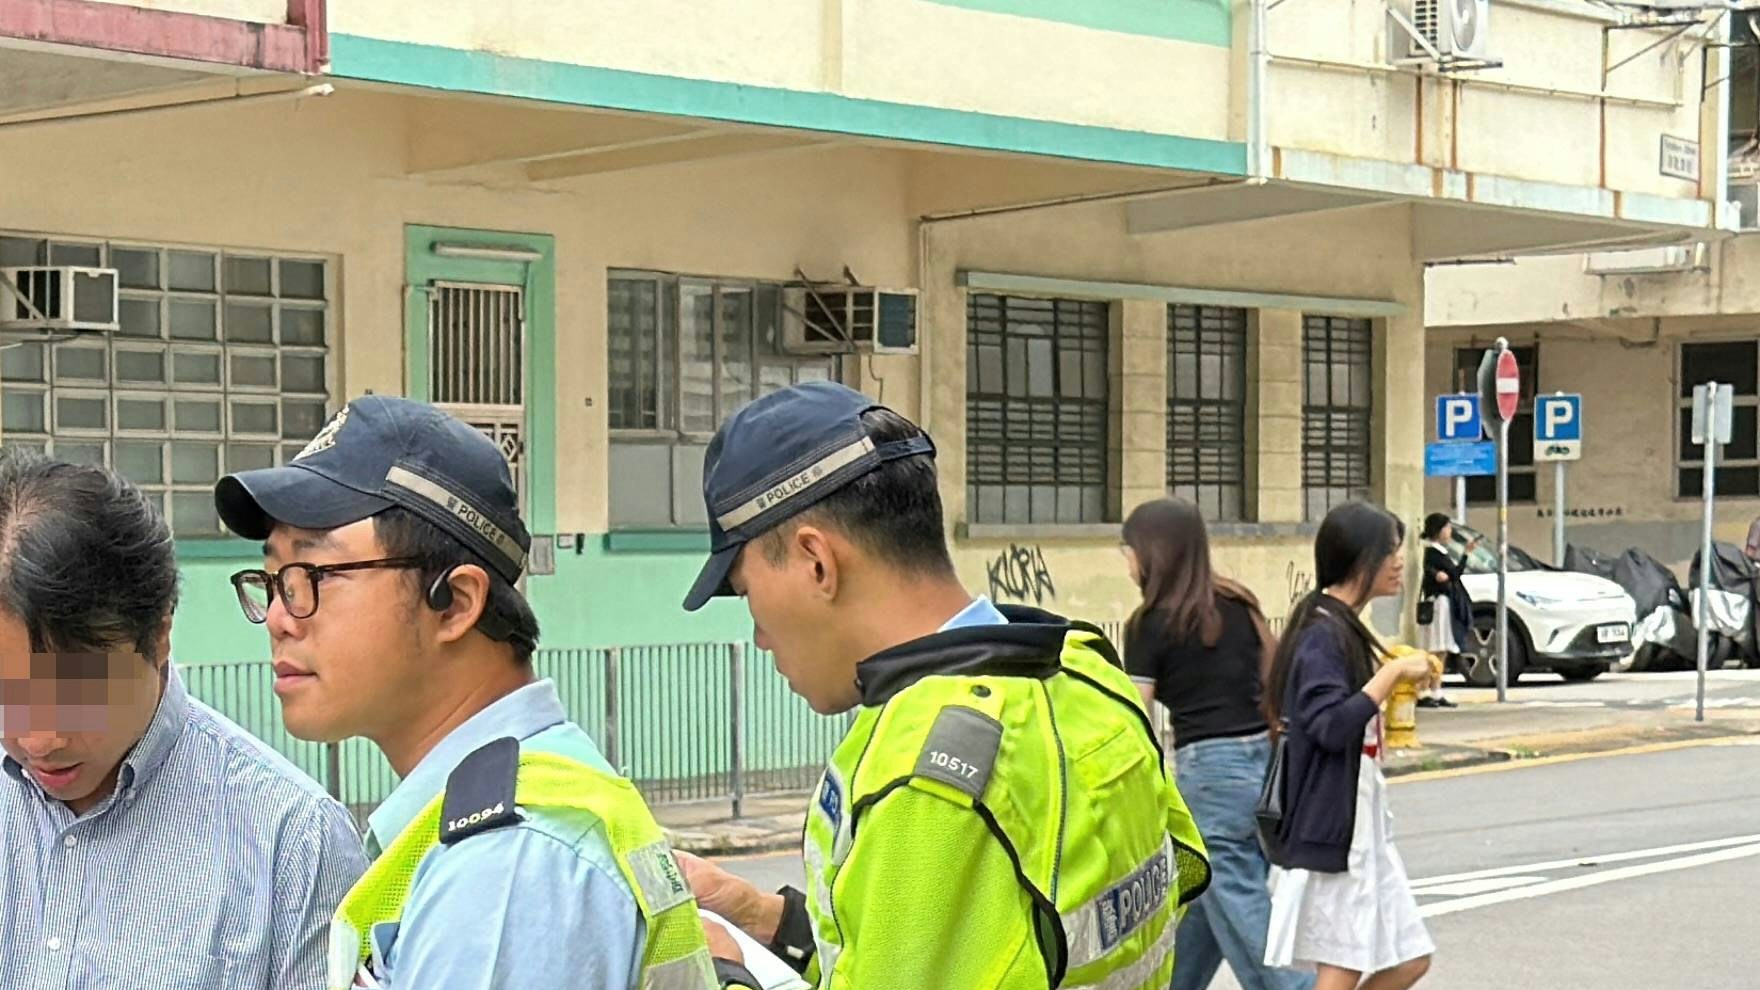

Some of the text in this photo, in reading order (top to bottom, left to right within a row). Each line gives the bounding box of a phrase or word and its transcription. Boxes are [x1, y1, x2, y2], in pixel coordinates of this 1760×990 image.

[1445, 399, 1473, 437] P
[1545, 400, 1573, 438] P
[766, 472, 810, 503] POLICE
[458, 504, 497, 540] POLICE
[930, 751, 978, 779] 10517
[448, 801, 504, 831] 10094
